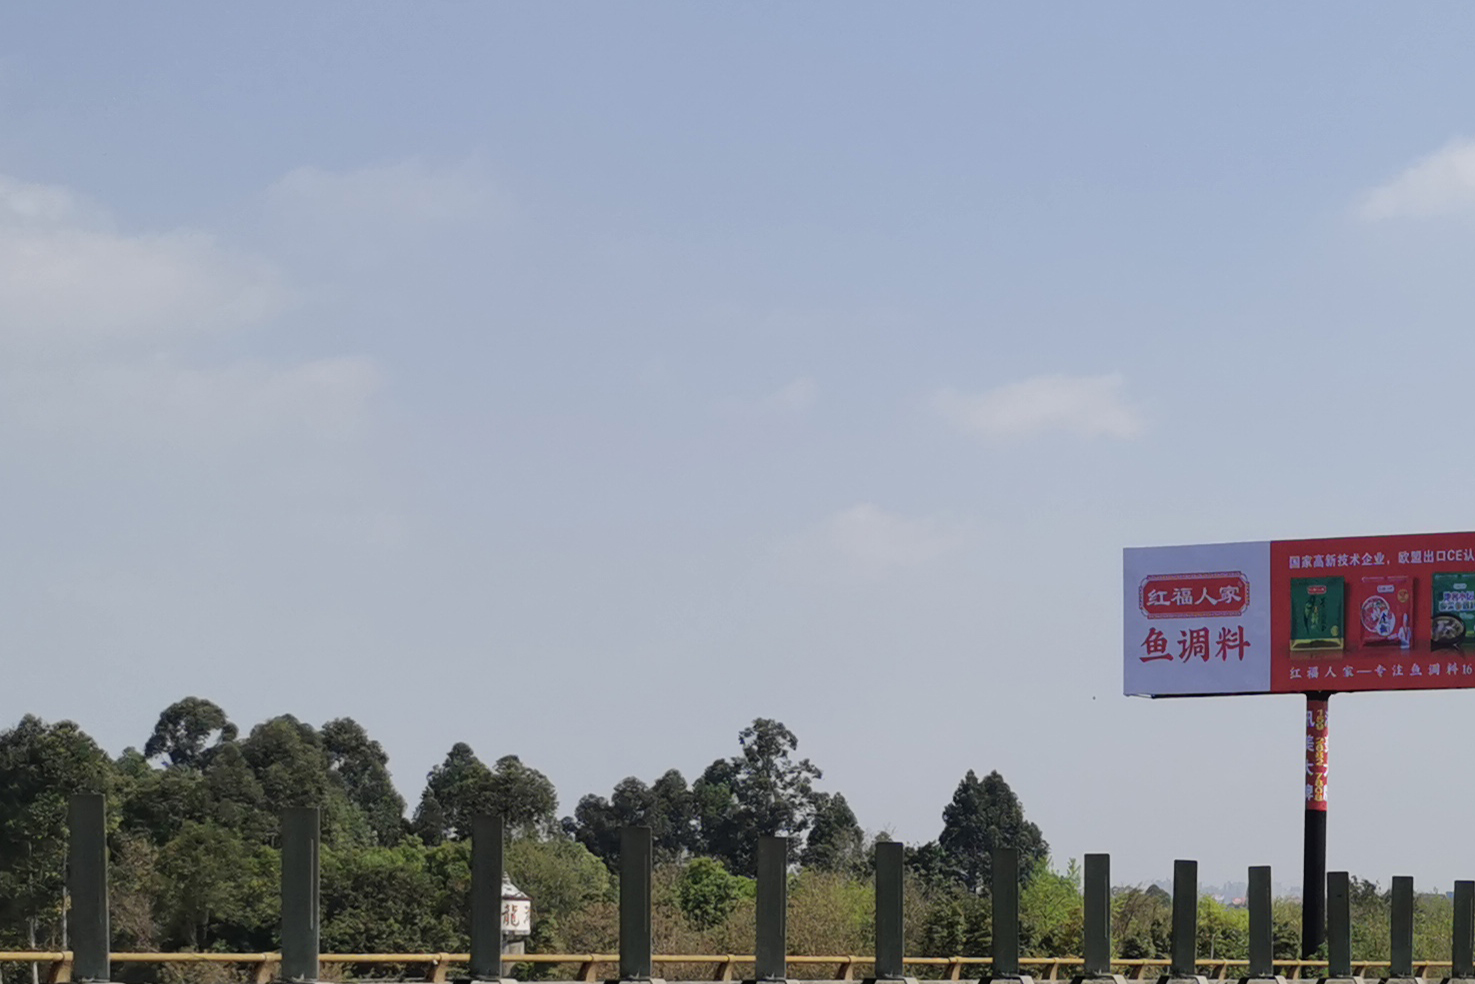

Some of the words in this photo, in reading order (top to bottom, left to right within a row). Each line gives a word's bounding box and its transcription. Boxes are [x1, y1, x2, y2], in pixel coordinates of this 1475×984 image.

[1146, 585, 1242, 606] 红福人家
[1139, 625, 1251, 663] 鱼调料
